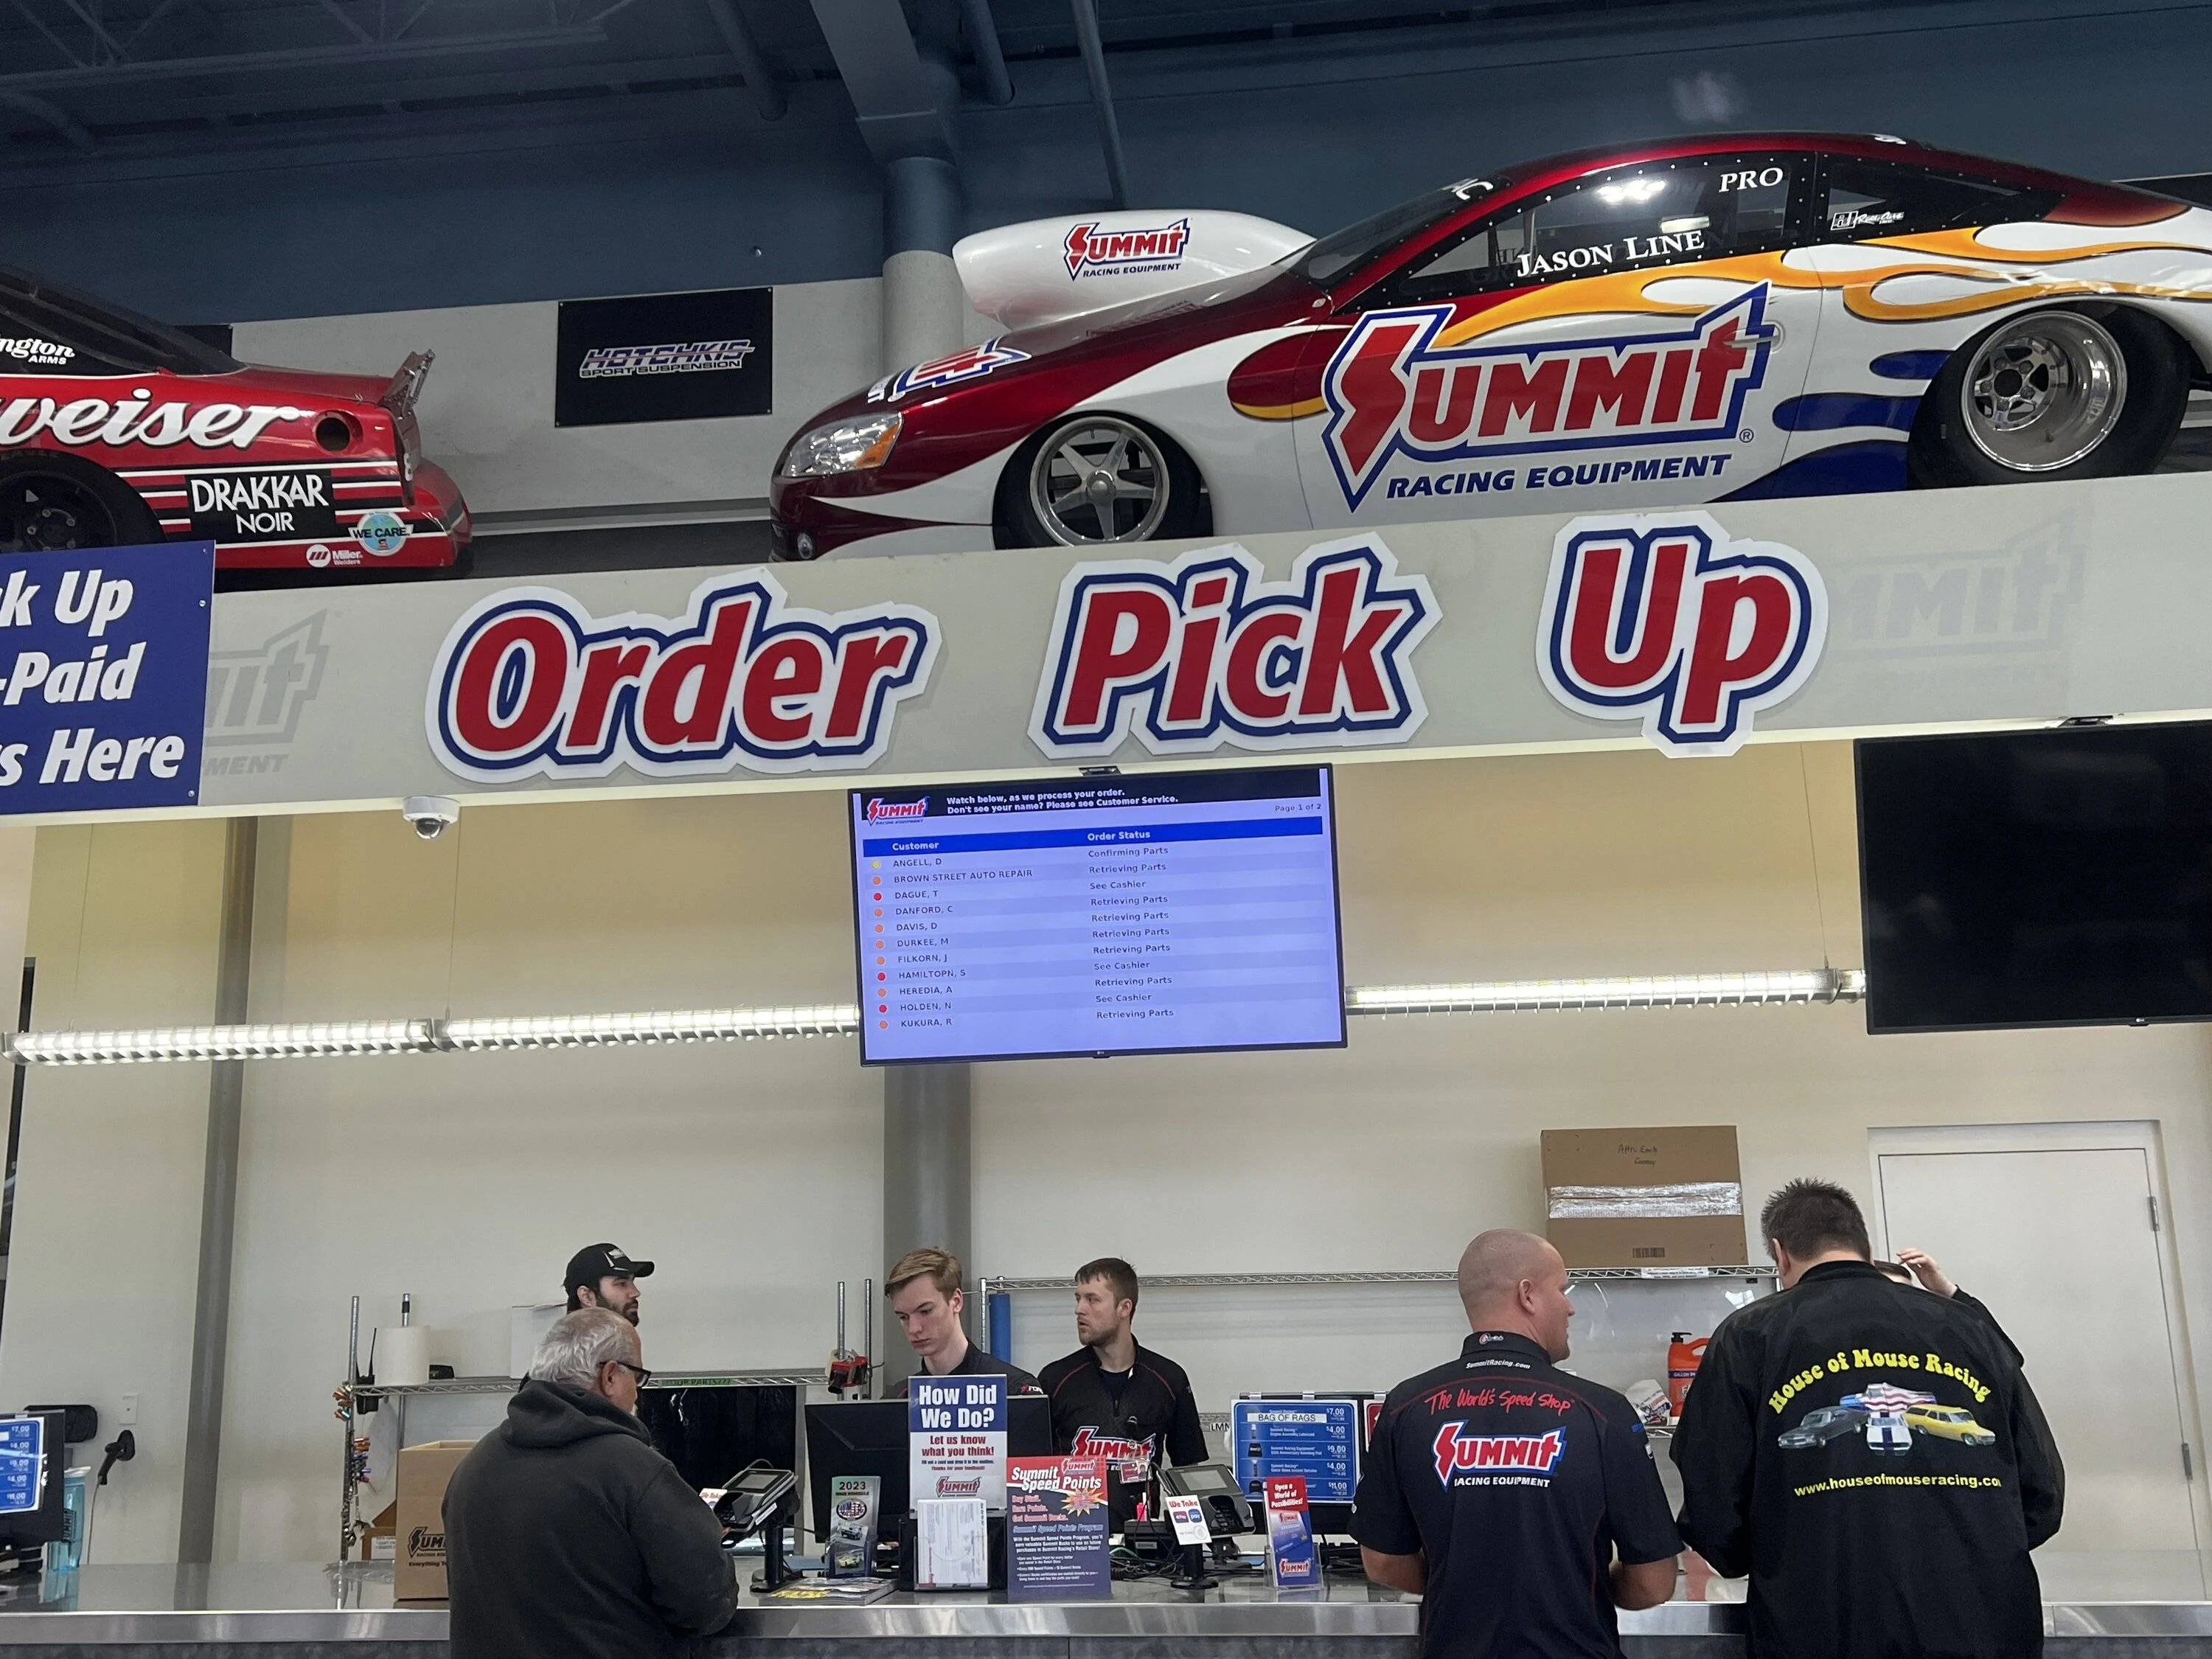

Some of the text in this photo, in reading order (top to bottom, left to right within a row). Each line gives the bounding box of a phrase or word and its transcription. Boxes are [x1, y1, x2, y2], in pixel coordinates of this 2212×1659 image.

[1719, 167, 1784, 193] PRO
[1065, 220, 1187, 276] SUMMIT
[1517, 230, 1705, 277] JASON LINE
[1083, 263, 1181, 278] RACING EQUIPMENT
[28, 355, 66, 365] ARMS
[582, 340, 754, 369] HOTCHKIS
[581, 360, 741, 377] SPORT SUSPENSION
[1335, 304, 1752, 485] SUMMIT
[1386, 453, 1732, 499] RACING EQUIPMENT
[191, 474, 329, 512] DRAKKAR
[236, 512, 295, 533] NOIR
[352, 529, 372, 538] WE
[0, 568, 134, 637] k Up
[448, 541, 1792, 758] Order Pick Up
[0, 728, 185, 787] s Here
[947, 796, 975, 804] Watch
[978, 794, 1006, 804] below,
[1037, 791, 1072, 801] process
[1074, 790, 1095, 799] your
[1097, 788, 1125, 796] order.
[867, 797, 928, 823] SUMMIT
[947, 806, 971, 814] Don't
[991, 804, 1012, 813] your
[1015, 802, 1043, 811] name?
[1046, 801, 1075, 810] Please
[1096, 797, 1139, 806] Customer
[1142, 796, 1179, 804] Service.
[1275, 804, 1295, 813] Page
[1088, 830, 1151, 841] Order Status
[892, 841, 939, 851] Customer
[1088, 846, 1169, 858] Confirming Parts
[893, 859, 931, 868] ANGELL,
[1089, 863, 1166, 874] Retrieving Parts
[894, 869, 1032, 883] BROWN STREET AUTO REPAIR
[1110, 880, 1147, 888] Cashier
[894, 890, 939, 900] DAGUE, T
[1091, 895, 1168, 906] Retrieving Parts
[895, 906, 944, 916] DANFORD,
[1092, 911, 1169, 922] Retrieving Parts
[896, 923, 928, 931] DAVIS,
[1093, 928, 1169, 939] Retrieving Parts
[897, 939, 937, 947] DURKEE,
[1093, 944, 1170, 955] Retrieving Parts
[897, 954, 947, 964] FILKORN, J
[1094, 961, 1150, 970] See Cashier
[899, 970, 957, 979] HAMILTOPN,
[1095, 976, 1172, 987] Retrieving Parts
[900, 987, 942, 995] HEREDIA,
[1116, 993, 1152, 1002] Cashier
[900, 1003, 942, 1012] HOLDEN,
[1096, 1009, 1174, 1020] Retrieving Parts
[901, 1019, 942, 1027] KUKURA,
[1466, 1359, 1531, 1369] SummitRacing.com
[1768, 1349, 1991, 1414] House of Mouse Racing
[919, 1384, 997, 1405] How Did
[1425, 1388, 1572, 1416] The World's Speed Shop
[1293, 1413, 1316, 1422] RAGS
[1326, 1408, 1344, 1416] $7.00
[922, 1408, 994, 1428] We Do?
[930, 1436, 944, 1444] Let
[961, 1435, 986, 1444] know
[1072, 1427, 1155, 1460] SUMMT
[922, 1447, 994, 1457] what you think!
[1327, 1445, 1346, 1453] $9.00
[1431, 1421, 1565, 1488] SUMMIT
[1327, 1462, 1346, 1470] $4.00
[1012, 1467, 1059, 1481] Summit
[839, 1481, 866, 1490] 2023
[936, 1477, 980, 1496] SUMMIT
[1021, 1476, 1102, 1494] Speed Points
[1492, 1477, 1551, 1489] EQUIPMENT
[408, 1527, 445, 1556] SUM
[1280, 1559, 1310, 1576] SUMMIT
